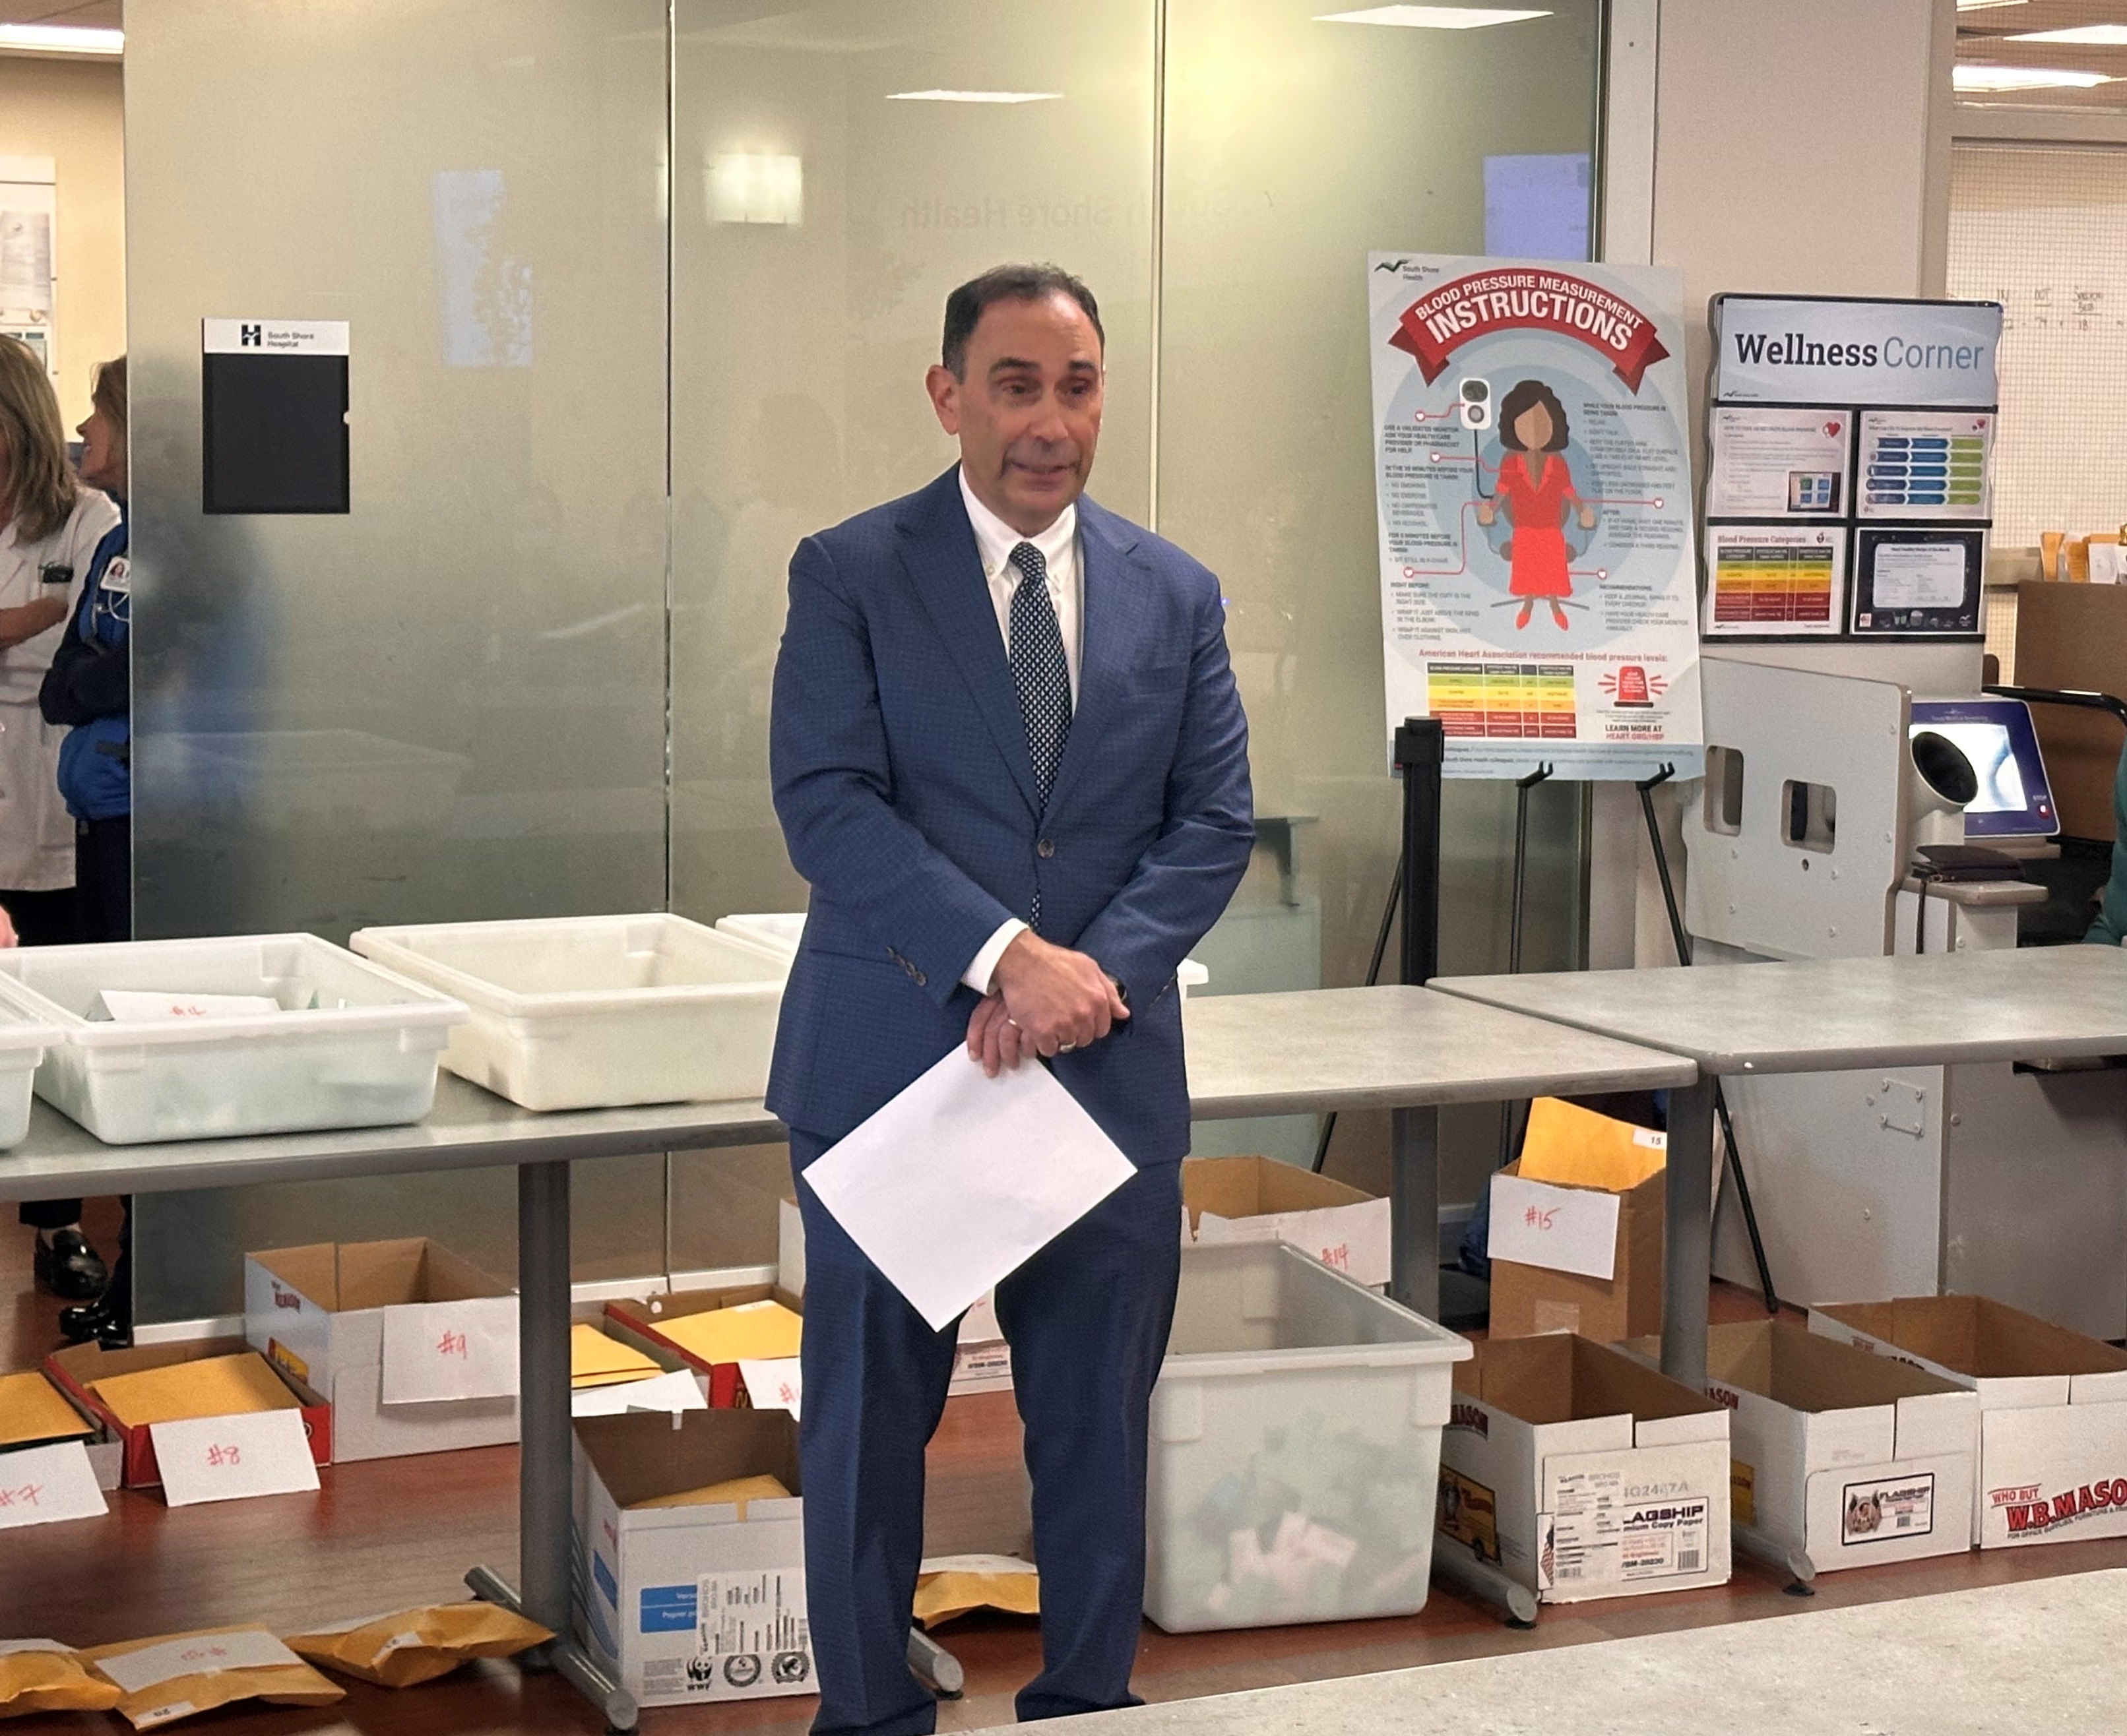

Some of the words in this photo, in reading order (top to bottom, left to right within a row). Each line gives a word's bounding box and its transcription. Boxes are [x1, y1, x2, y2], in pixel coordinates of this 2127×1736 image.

[1415, 288, 1460, 321] BLOOD
[1463, 274, 1536, 295] PRESSURE
[1539, 276, 1643, 330] MEASUREMENT
[1425, 290, 1633, 352] INSTRUCTIONS
[1734, 332, 1878, 367] Wellness
[1883, 336, 1984, 371] Corner
[1717, 535, 1737, 543] Blood
[1738, 535, 1769, 543] Pressure
[1770, 536, 1806, 545] Categories
[1419, 649, 1456, 658] American
[1529, 652, 1583, 660] recommended
[1651, 1136, 1661, 1146] 15
[1525, 1205, 1561, 1230] #15
[1322, 1243, 1349, 1270] #14
[437, 1329, 467, 1359] #9
[207, 1444, 241, 1467] #8
[0, 1484, 43, 1506] #7
[1992, 1491, 2016, 1504] WHO
[2019, 1488, 2040, 1501] BUT
[1676, 1518, 1703, 1527] Paper
[2021, 1529, 2043, 1538] OFFICE
